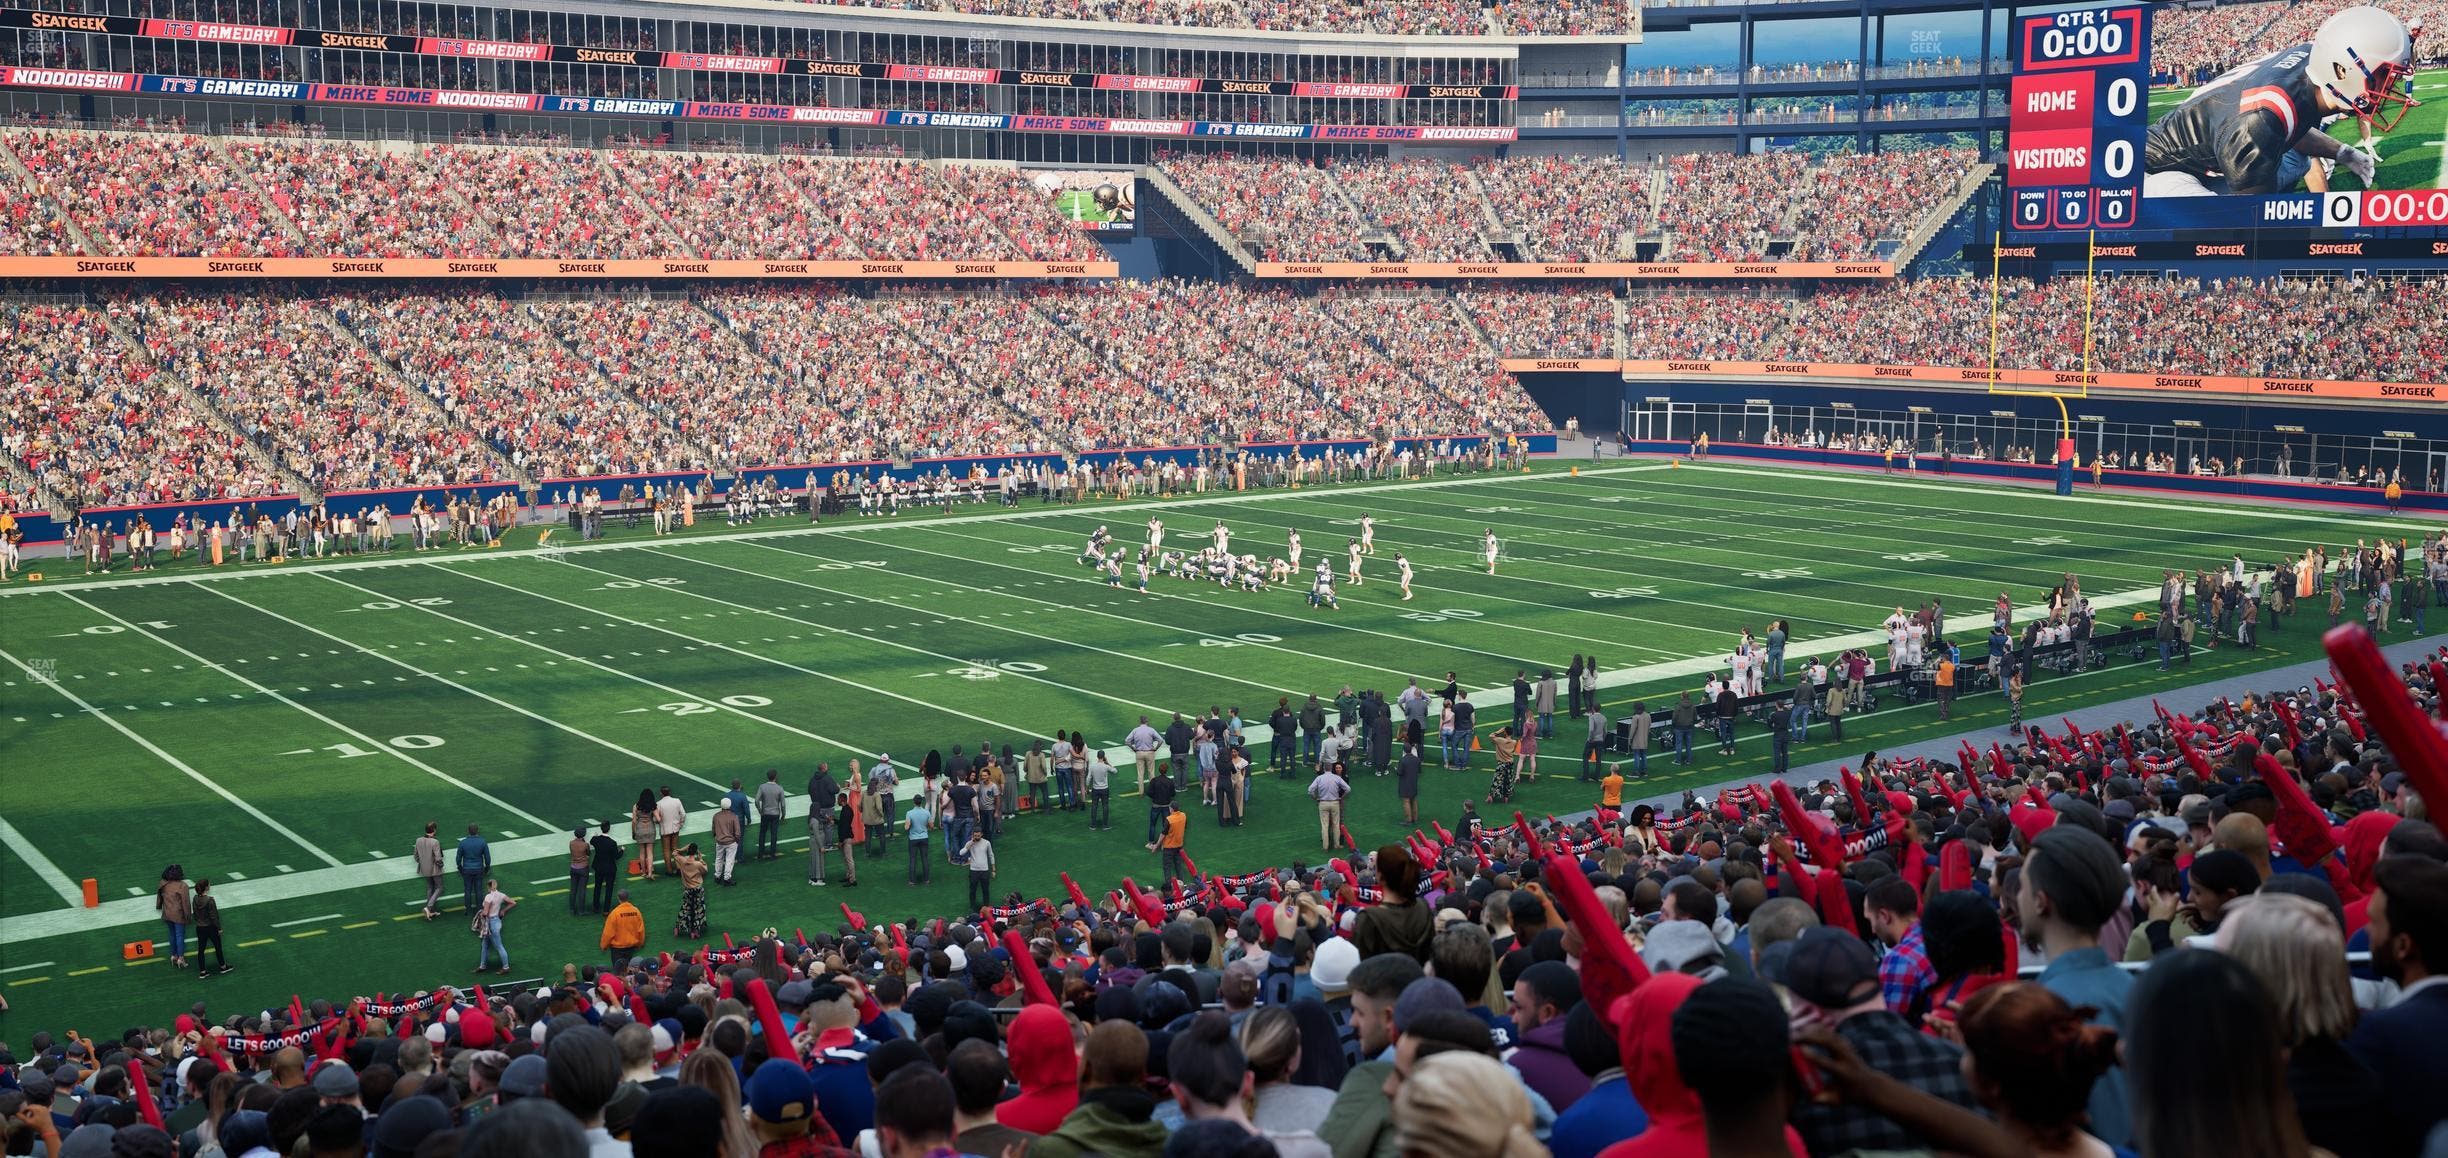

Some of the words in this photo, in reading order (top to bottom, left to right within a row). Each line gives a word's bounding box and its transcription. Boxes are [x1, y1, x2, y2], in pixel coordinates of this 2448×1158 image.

[32, 13, 108, 32] SEATGEEK
[2057, 11, 2094, 27] QTR
[2100, 10, 2108, 22] 1
[163, 23, 192, 36] IT'S
[198, 25, 278, 43] GAMEDAY!
[321, 33, 388, 50] SEATGEEK
[2043, 24, 2122, 58] 0:00
[436, 40, 463, 54] IT'S
[467, 42, 538, 59] GAMEDAY!
[576, 49, 637, 65] SEATGEEK
[679, 55, 703, 67] IT'S
[707, 57, 772, 72] GAMEDAY!
[807, 62, 861, 76] SEATGEEK
[902, 66, 925, 79] IT'S
[928, 68, 990, 84] GAMEDAY!
[12, 70, 125, 89] NOOOOISE!!!
[1020, 72, 1072, 86] SEATGEEK
[1109, 75, 1131, 88] IT'S
[1134, 77, 1191, 91] GAMEDAY!
[161, 78, 197, 93] IT'S
[202, 80, 298, 98] GAMEDAY!
[1222, 81, 1271, 94] SEATGEEK
[1309, 84, 1330, 95] IT'S
[1334, 85, 1396, 97] GAMEDAY!
[1429, 86, 1482, 98] SEATGEEK
[325, 87, 379, 103] MAKE
[386, 89, 432, 104] SOME
[436, 92, 529, 110] NOOOOISE!!!
[2027, 90, 2076, 112] HOME
[2107, 78, 2137, 117] 0
[559, 97, 589, 111] IT'S
[594, 99, 675, 115] GAMEDAY!
[697, 104, 745, 118] MAKE
[749, 106, 790, 119] SOME
[793, 108, 873, 124] NOOOOISE!!!
[900, 112, 926, 125] IT'S
[930, 113, 1003, 129] GAMEDAY!
[1023, 116, 1066, 129] MAKE
[1069, 118, 1106, 131] SOME
[1109, 118, 1182, 135] NOOOOISE!!!
[1207, 123, 1232, 135] IT'S
[1235, 123, 1304, 138] GAMEDAY!
[1326, 127, 1370, 138] MAKE
[1376, 128, 1418, 138] SOME
[1421, 128, 1515, 139] NOOOOISE!!!
[2013, 147, 2087, 170] VISITORS
[2104, 139, 2134, 179] 0
[2074, 190, 2087, 198] GO
[2025, 202, 2039, 221] 0
[2065, 201, 2080, 220] 0
[2108, 200, 2123, 219] 0
[2264, 199, 2314, 220] HOME
[2331, 195, 2352, 222] 0
[2092, 245, 2137, 256] SEATGEEK
[2195, 244, 2245, 256] SEATGEEK
[2309, 243, 2362, 255] SEATGEEK
[2432, 242, 2448, 254] SE
[77, 261, 136, 274] SEATGEEK
[208, 261, 264, 274] SEATGEEK
[332, 262, 384, 274] SEATGEEK
[448, 262, 498, 274] SEATGEEK
[559, 262, 605, 274] SEATGEEK
[664, 263, 709, 274] SEATGEEK
[765, 263, 808, 274] SEATGEEK
[862, 264, 904, 274] SEATGEEK
[955, 264, 996, 274] SEATGEEK
[1046, 264, 1086, 274] SEATGEEK
[1284, 265, 1323, 275] SEATGEEK
[1370, 265, 1409, 275] SEATGEEK
[1457, 265, 1499, 275] SEATGEEK
[1544, 265, 1586, 275] SEATGEEK
[1638, 265, 1680, 275] SEATGEEK
[1734, 265, 1777, 275] SEATGEEK
[1834, 265, 1881, 275] SEATGEEK
[1536, 361, 1579, 370] SEATGEEK
[1668, 362, 1711, 372] SEATGEEK
[1765, 364, 1809, 374] SEATGEEK
[1874, 366, 1912, 377] SEATGEEK
[2155, 377, 2202, 389] SEATGEEK
[2264, 381, 2314, 393] SEATGEEK
[2381, 385, 2436, 397] SEATGEEK
[1589, 586, 1660, 599] 40
[1399, 608, 1484, 622] 50
[1200, 632, 1283, 648] 40
[657, 694, 773, 716] 20
[322, 734, 446, 759] 10
[1358, 887, 1383, 901] LET'S
[708, 952, 727, 961] LET'S
[366, 1004, 389, 1015] LET'S
[227, 1037, 258, 1052] LET'S
